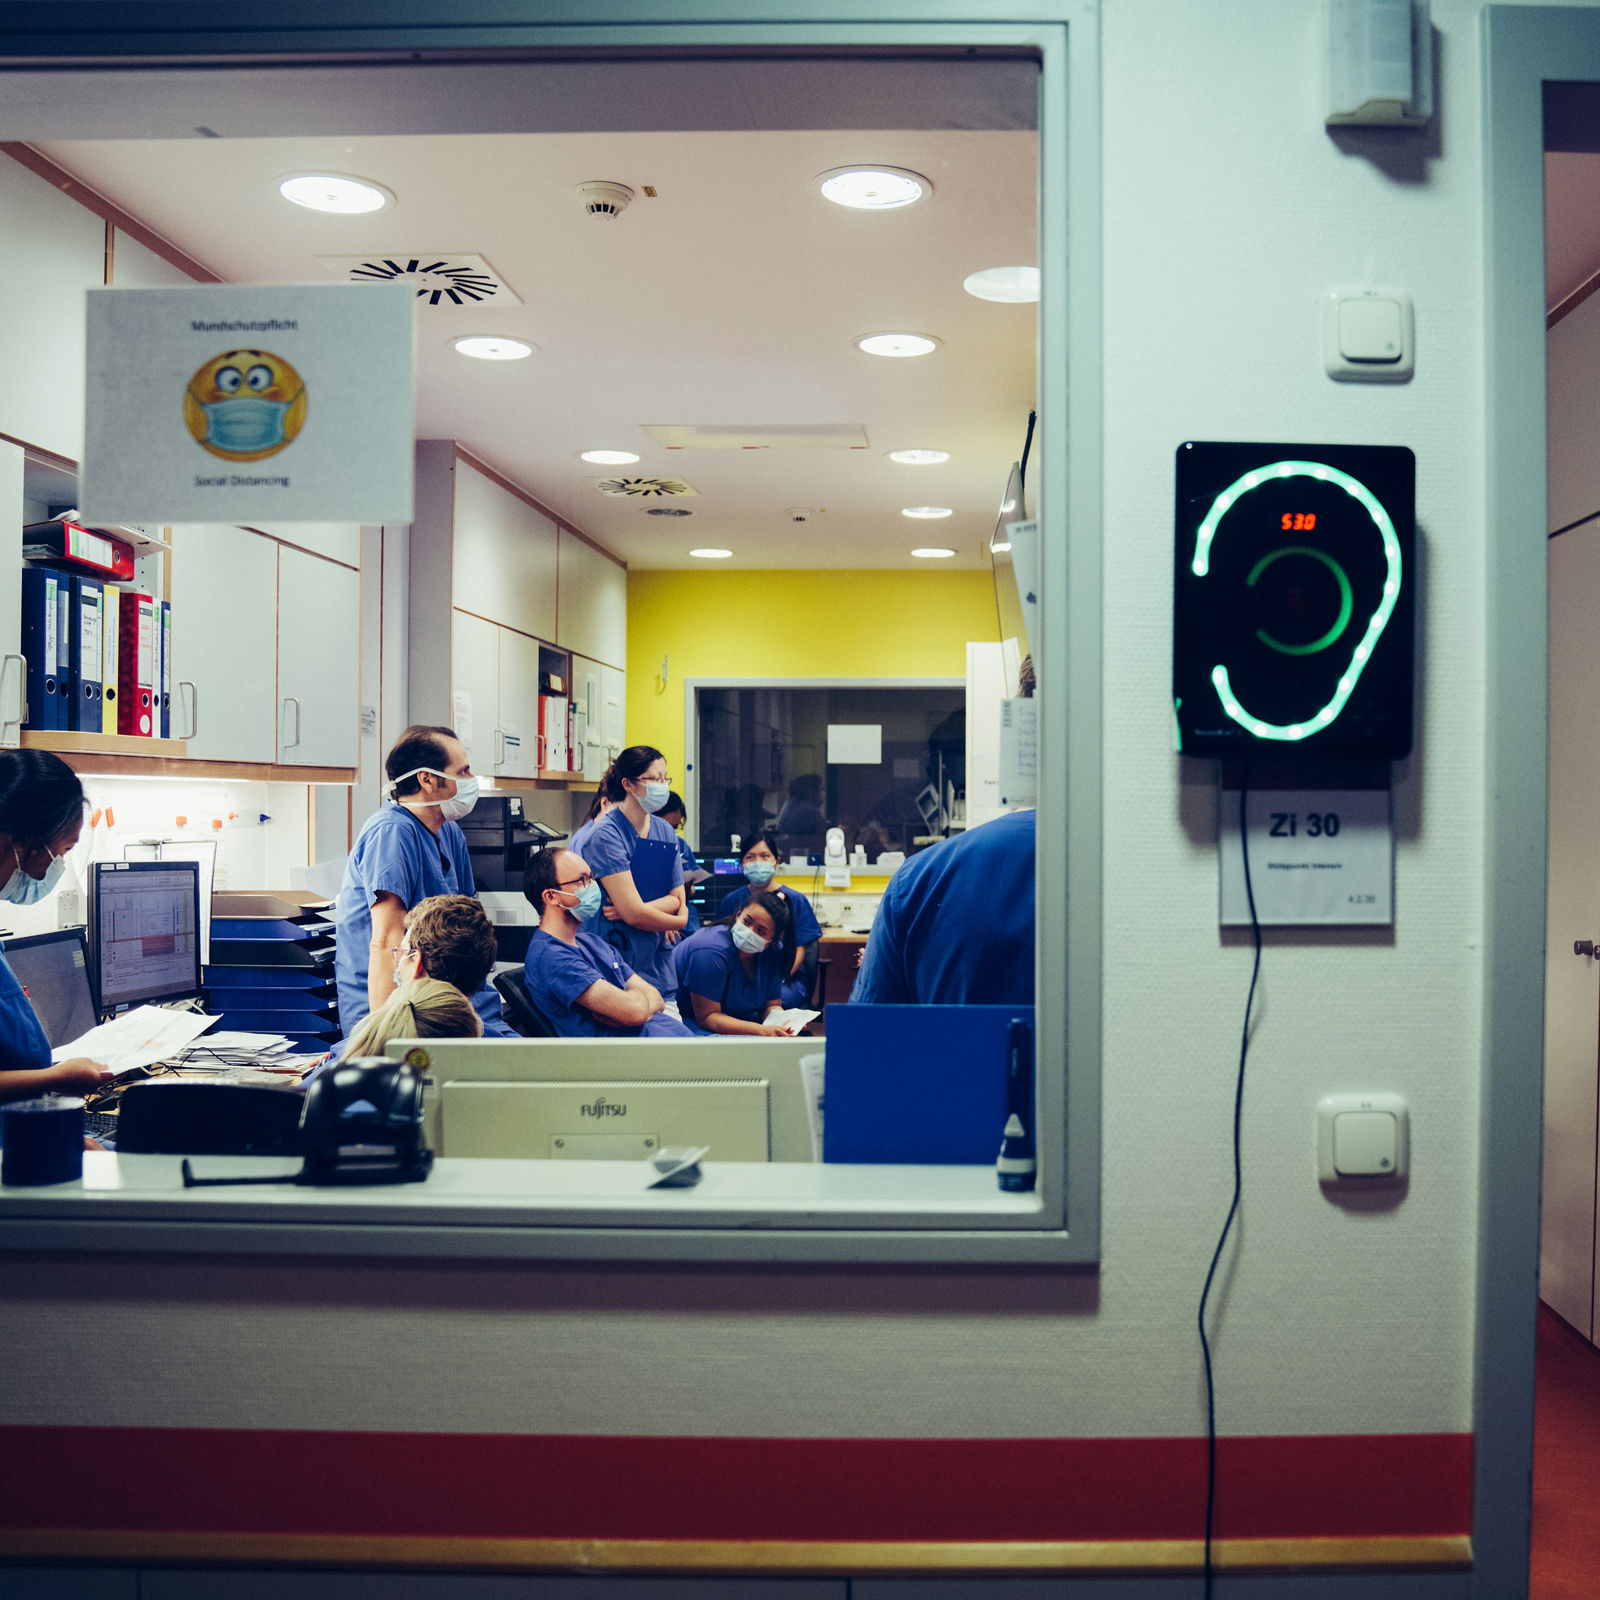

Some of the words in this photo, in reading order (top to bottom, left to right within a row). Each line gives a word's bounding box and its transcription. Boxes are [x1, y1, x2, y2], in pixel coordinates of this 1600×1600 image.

[191, 320, 299, 332] Mundschutzpflicht
[195, 475, 226, 487] Social
[230, 475, 290, 488] Distancing
[1269, 813, 1297, 837] Zi
[1306, 813, 1341, 837] 30
[581, 1098, 627, 1118] FUJITSU
